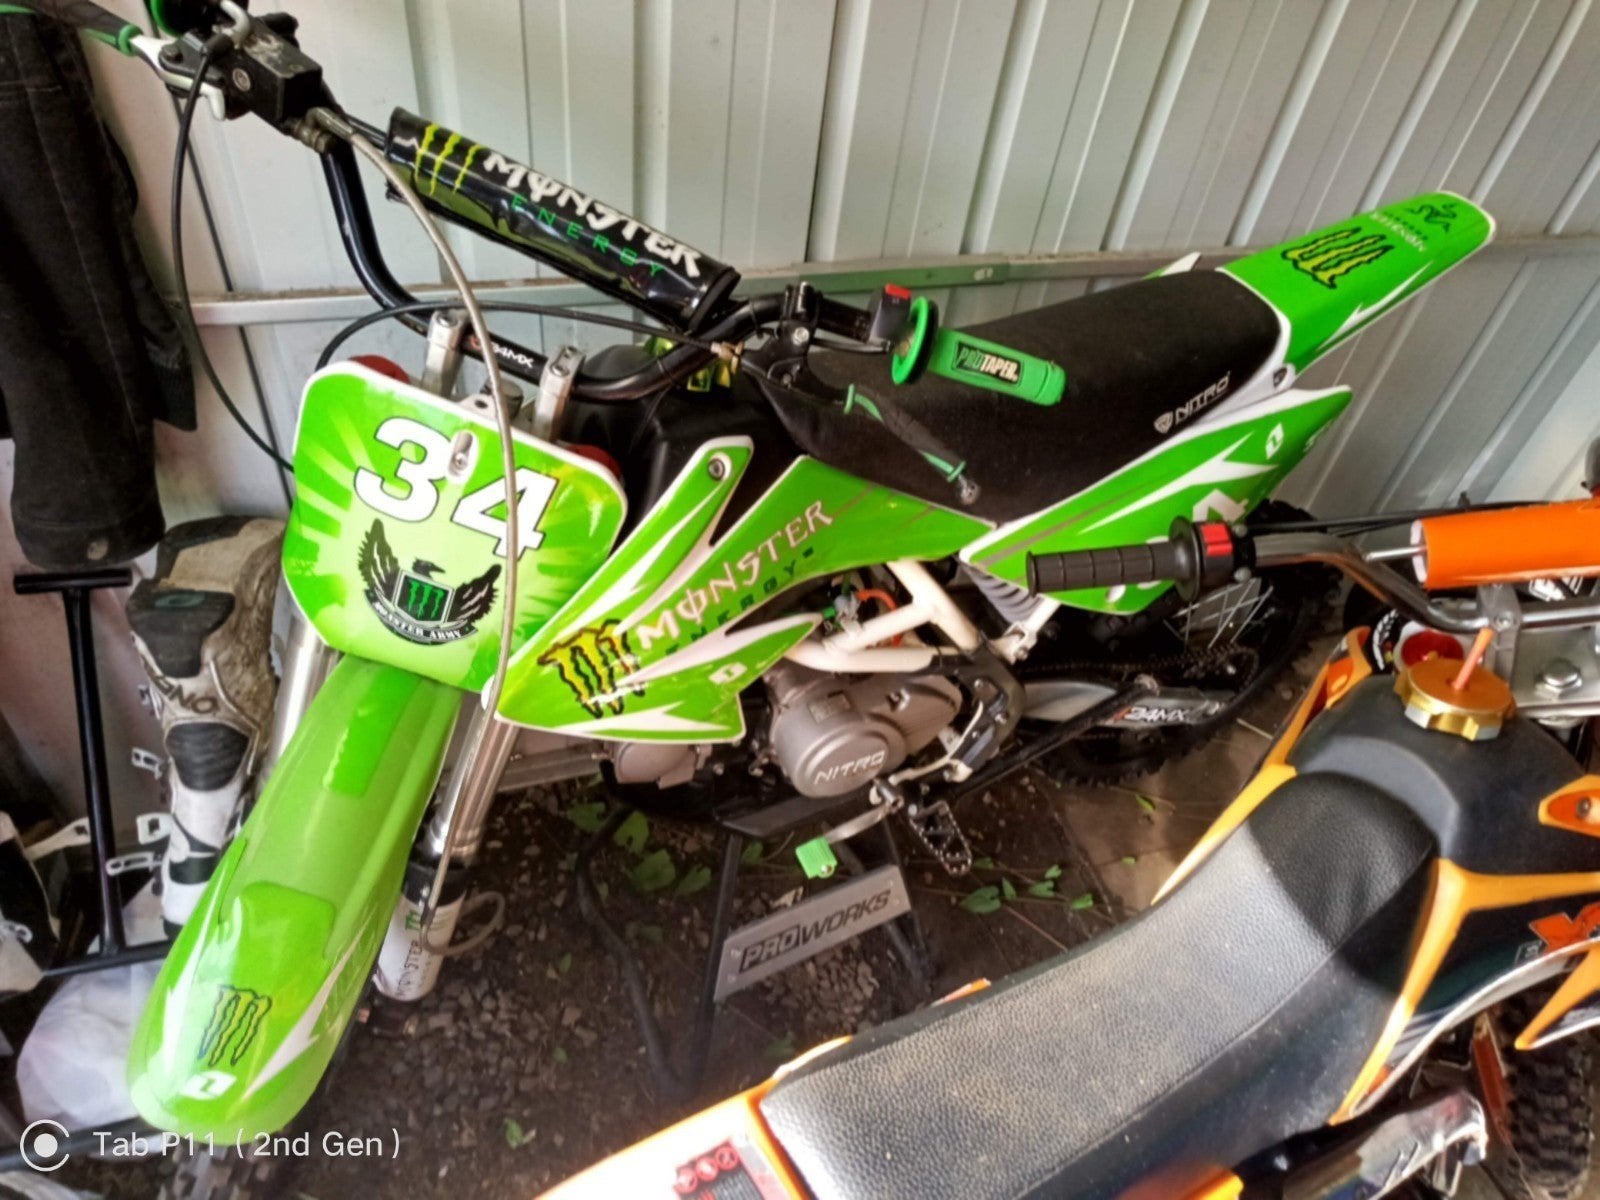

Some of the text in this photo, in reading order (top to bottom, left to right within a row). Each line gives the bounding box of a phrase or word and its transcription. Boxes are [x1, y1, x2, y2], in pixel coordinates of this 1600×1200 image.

[484, 150, 701, 278] MONSTER
[511, 194, 664, 277] ENERGY
[1174, 375, 1231, 425] NITRO
[354, 416, 559, 562] 34
[635, 500, 833, 650] MONSTER
[814, 750, 886, 784] NITRO
[739, 889, 891, 973] PROWORKS
